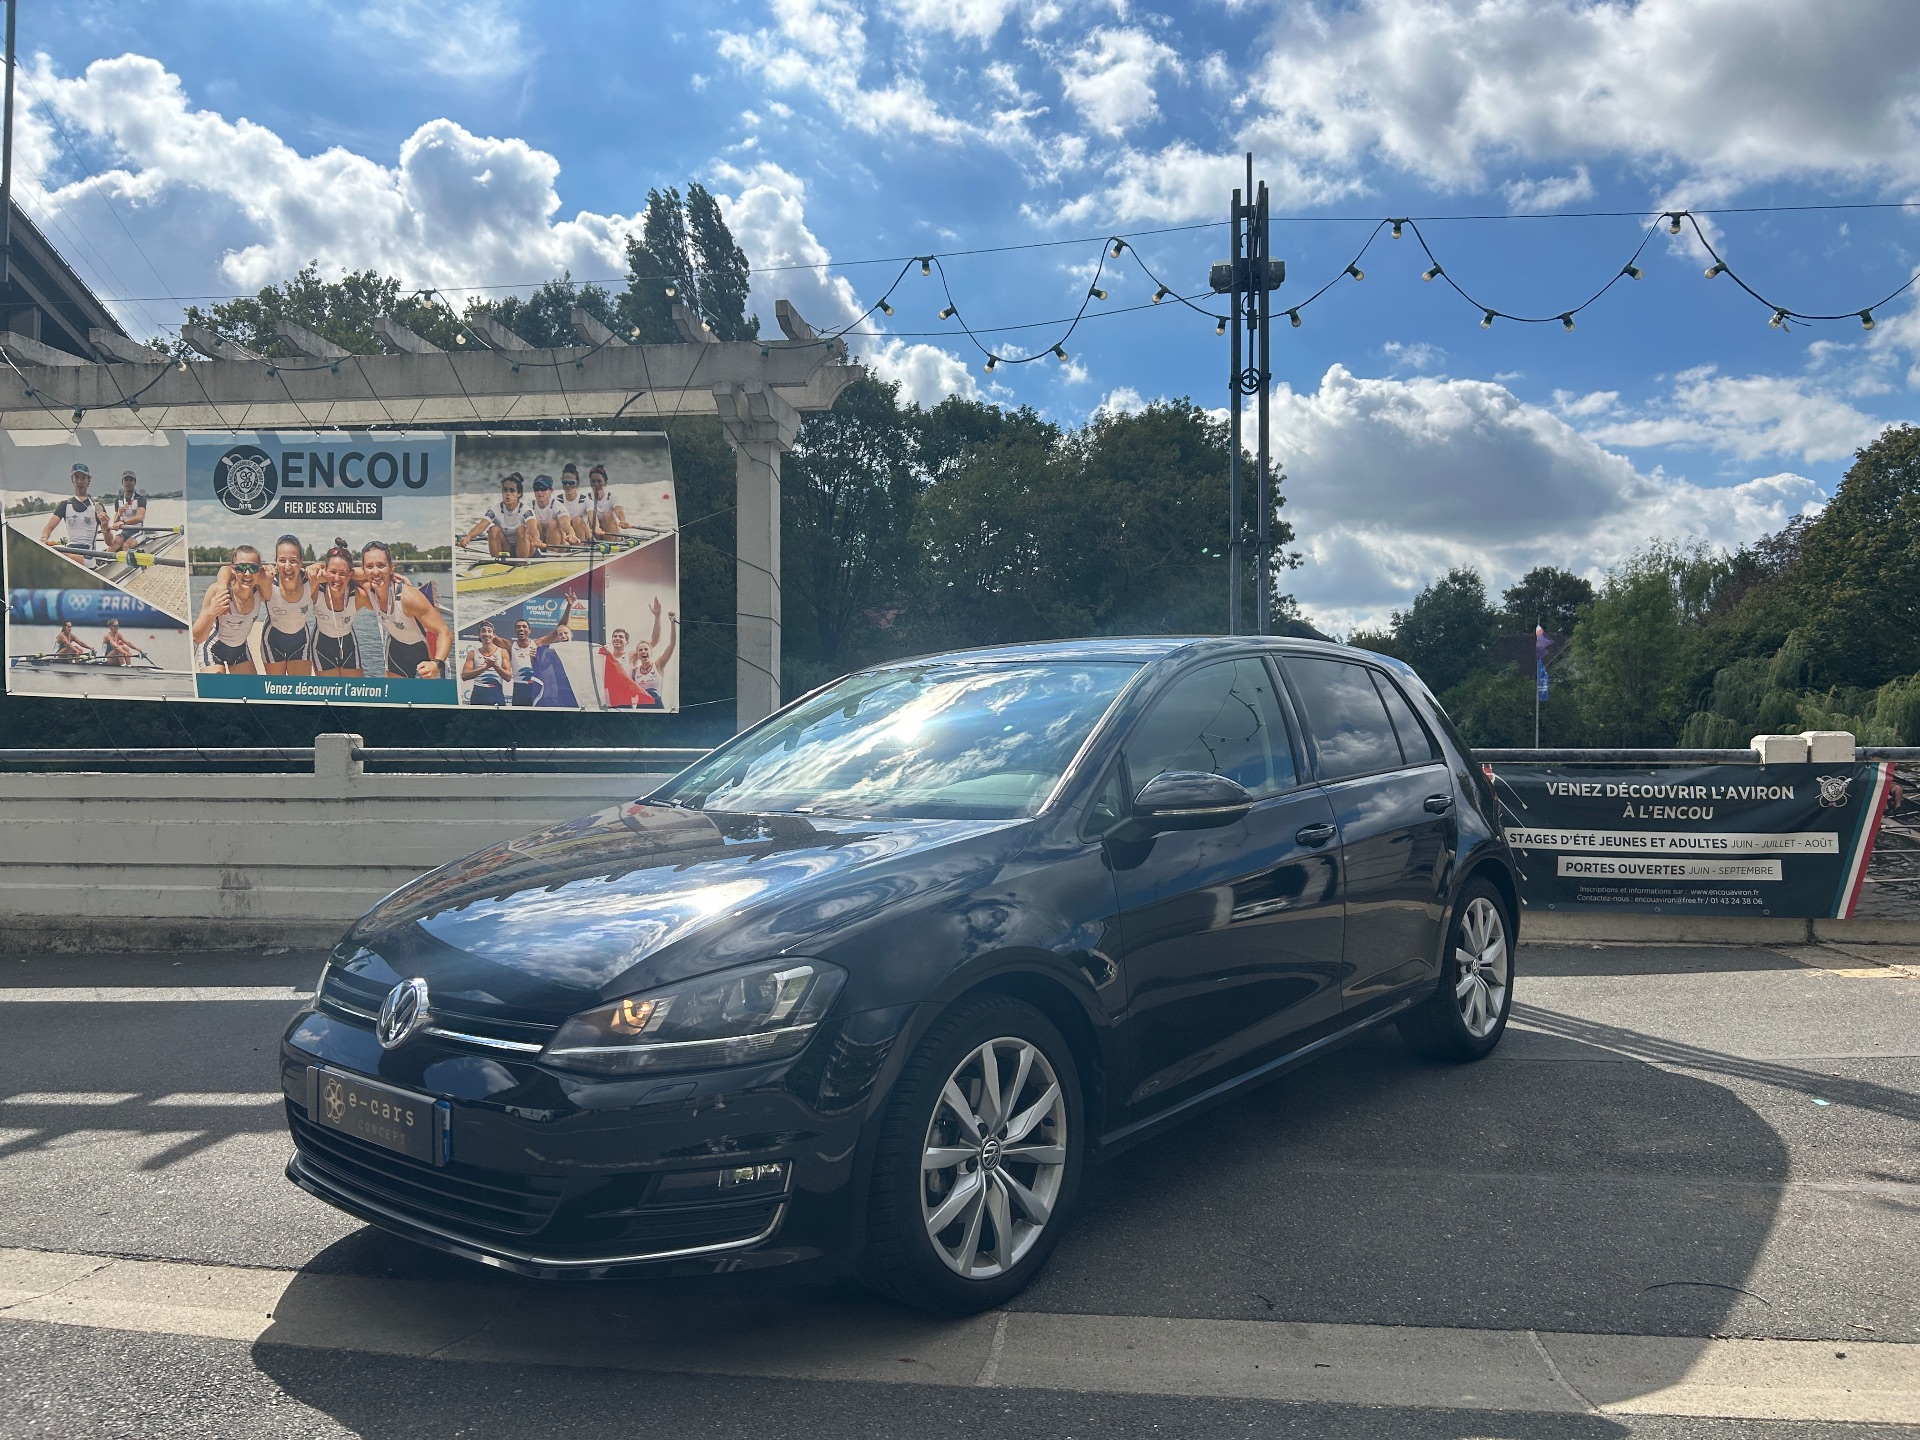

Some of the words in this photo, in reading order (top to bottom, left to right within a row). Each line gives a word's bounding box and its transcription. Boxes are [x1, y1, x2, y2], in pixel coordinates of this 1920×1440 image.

[282, 451, 429, 489] ENCOU
[284, 501, 304, 514] FIER
[305, 501, 317, 514] DE
[318, 501, 335, 514] SES
[336, 499, 377, 514] ATHLÈTES
[264, 681, 293, 695] Venez
[295, 681, 342, 696] découvrir
[344, 683, 382, 697] l'aviron
[1546, 782, 1602, 797] VENEZ
[1606, 781, 1707, 799] DÉCOUVRIR
[1711, 785, 1795, 800] L'AVIRON
[1622, 801, 1635, 818] À
[1639, 805, 1714, 820] L'ENCOU
[1509, 833, 1558, 845] STAGES
[1560, 833, 1596, 846] D'ÉTÉ
[1599, 836, 1647, 847] JEUNES
[1650, 837, 1665, 848] ET
[1669, 838, 1728, 849] ADULTES
[1731, 840, 1753, 848] JUIN
[1761, 839, 1796, 848] JUILLET
[1804, 838, 1833, 848] AOÛT
[1566, 862, 1615, 873] PORTES
[1618, 863, 1685, 875] OUVERTES
[1689, 866, 1710, 875] JUIN
[1718, 866, 1774, 875] SEPTEMBRE
[1628, 887, 1672, 895] informations
[1576, 894, 1630, 902] Contactez-nous
[1752, 897, 1763, 905] 06
[348, 1092, 414, 1126] e-cars
[358, 1119, 406, 1145] CONCEPT
